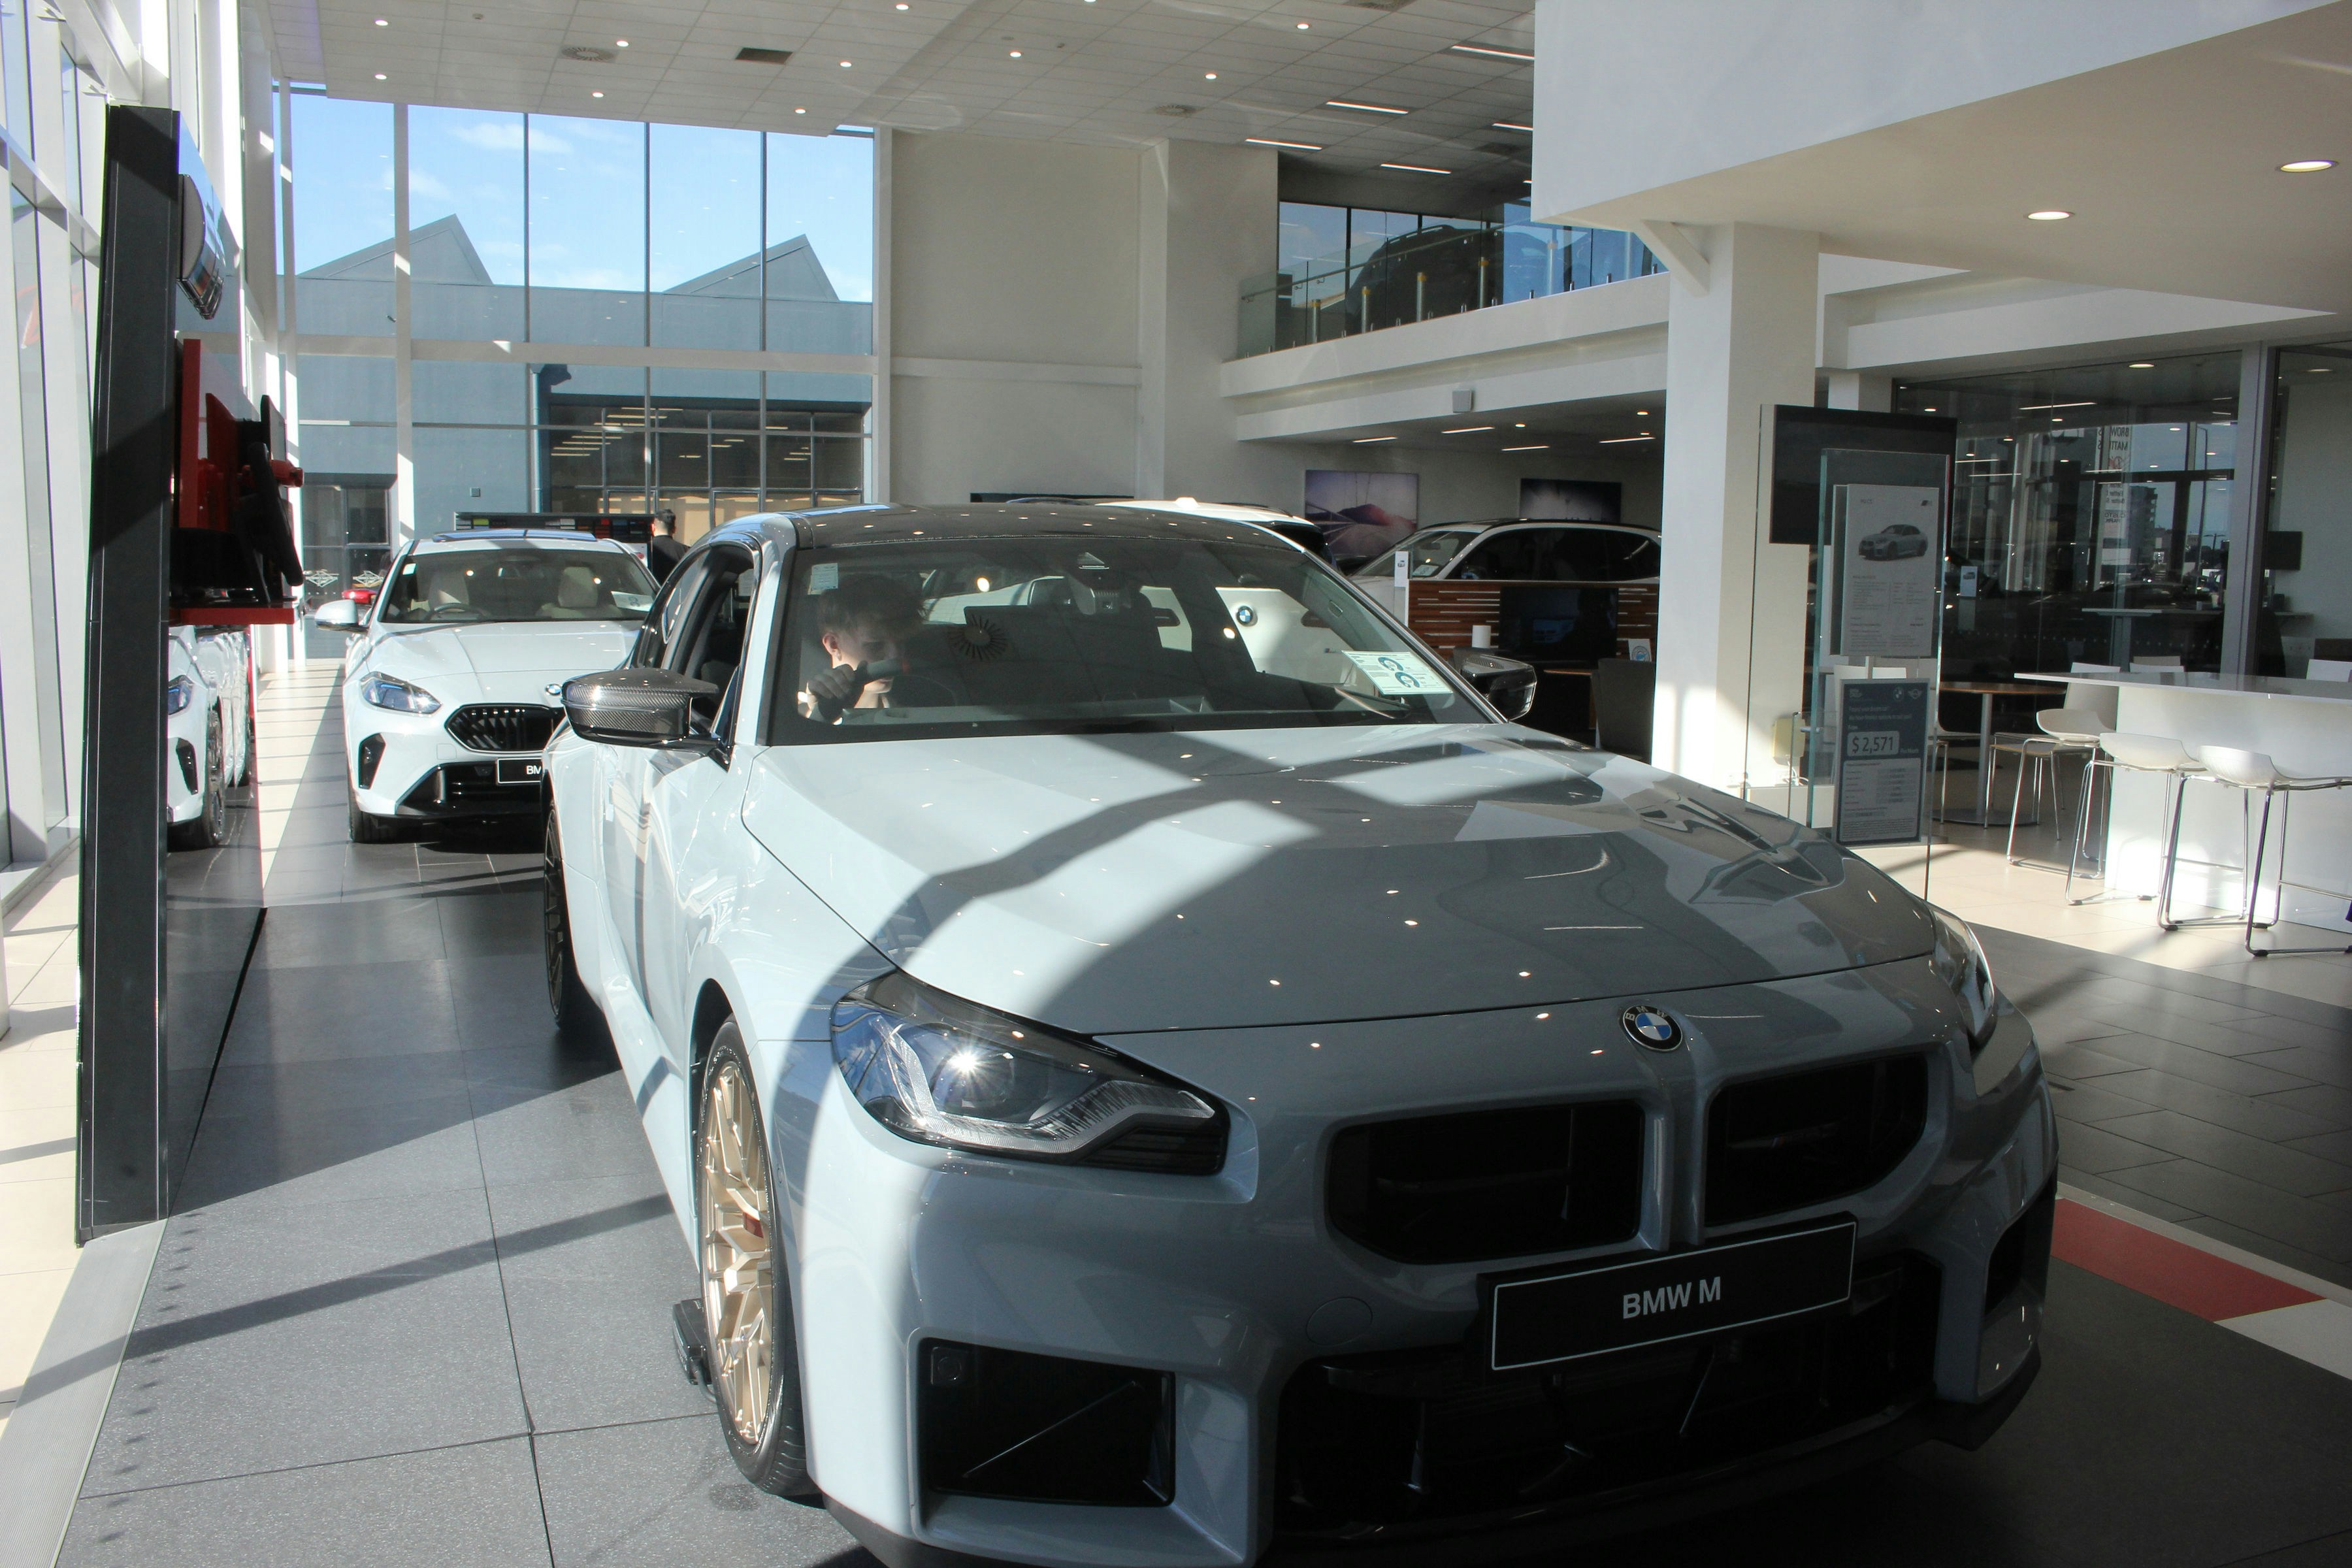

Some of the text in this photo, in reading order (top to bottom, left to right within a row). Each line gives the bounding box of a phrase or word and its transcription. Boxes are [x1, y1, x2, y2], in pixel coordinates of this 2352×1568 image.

[1862, 736, 1893, 753] 2,571
[526, 765, 542, 775] BM
[1625, 1005, 1667, 1021] BMW
[1623, 1276, 1721, 1319] BMW M
